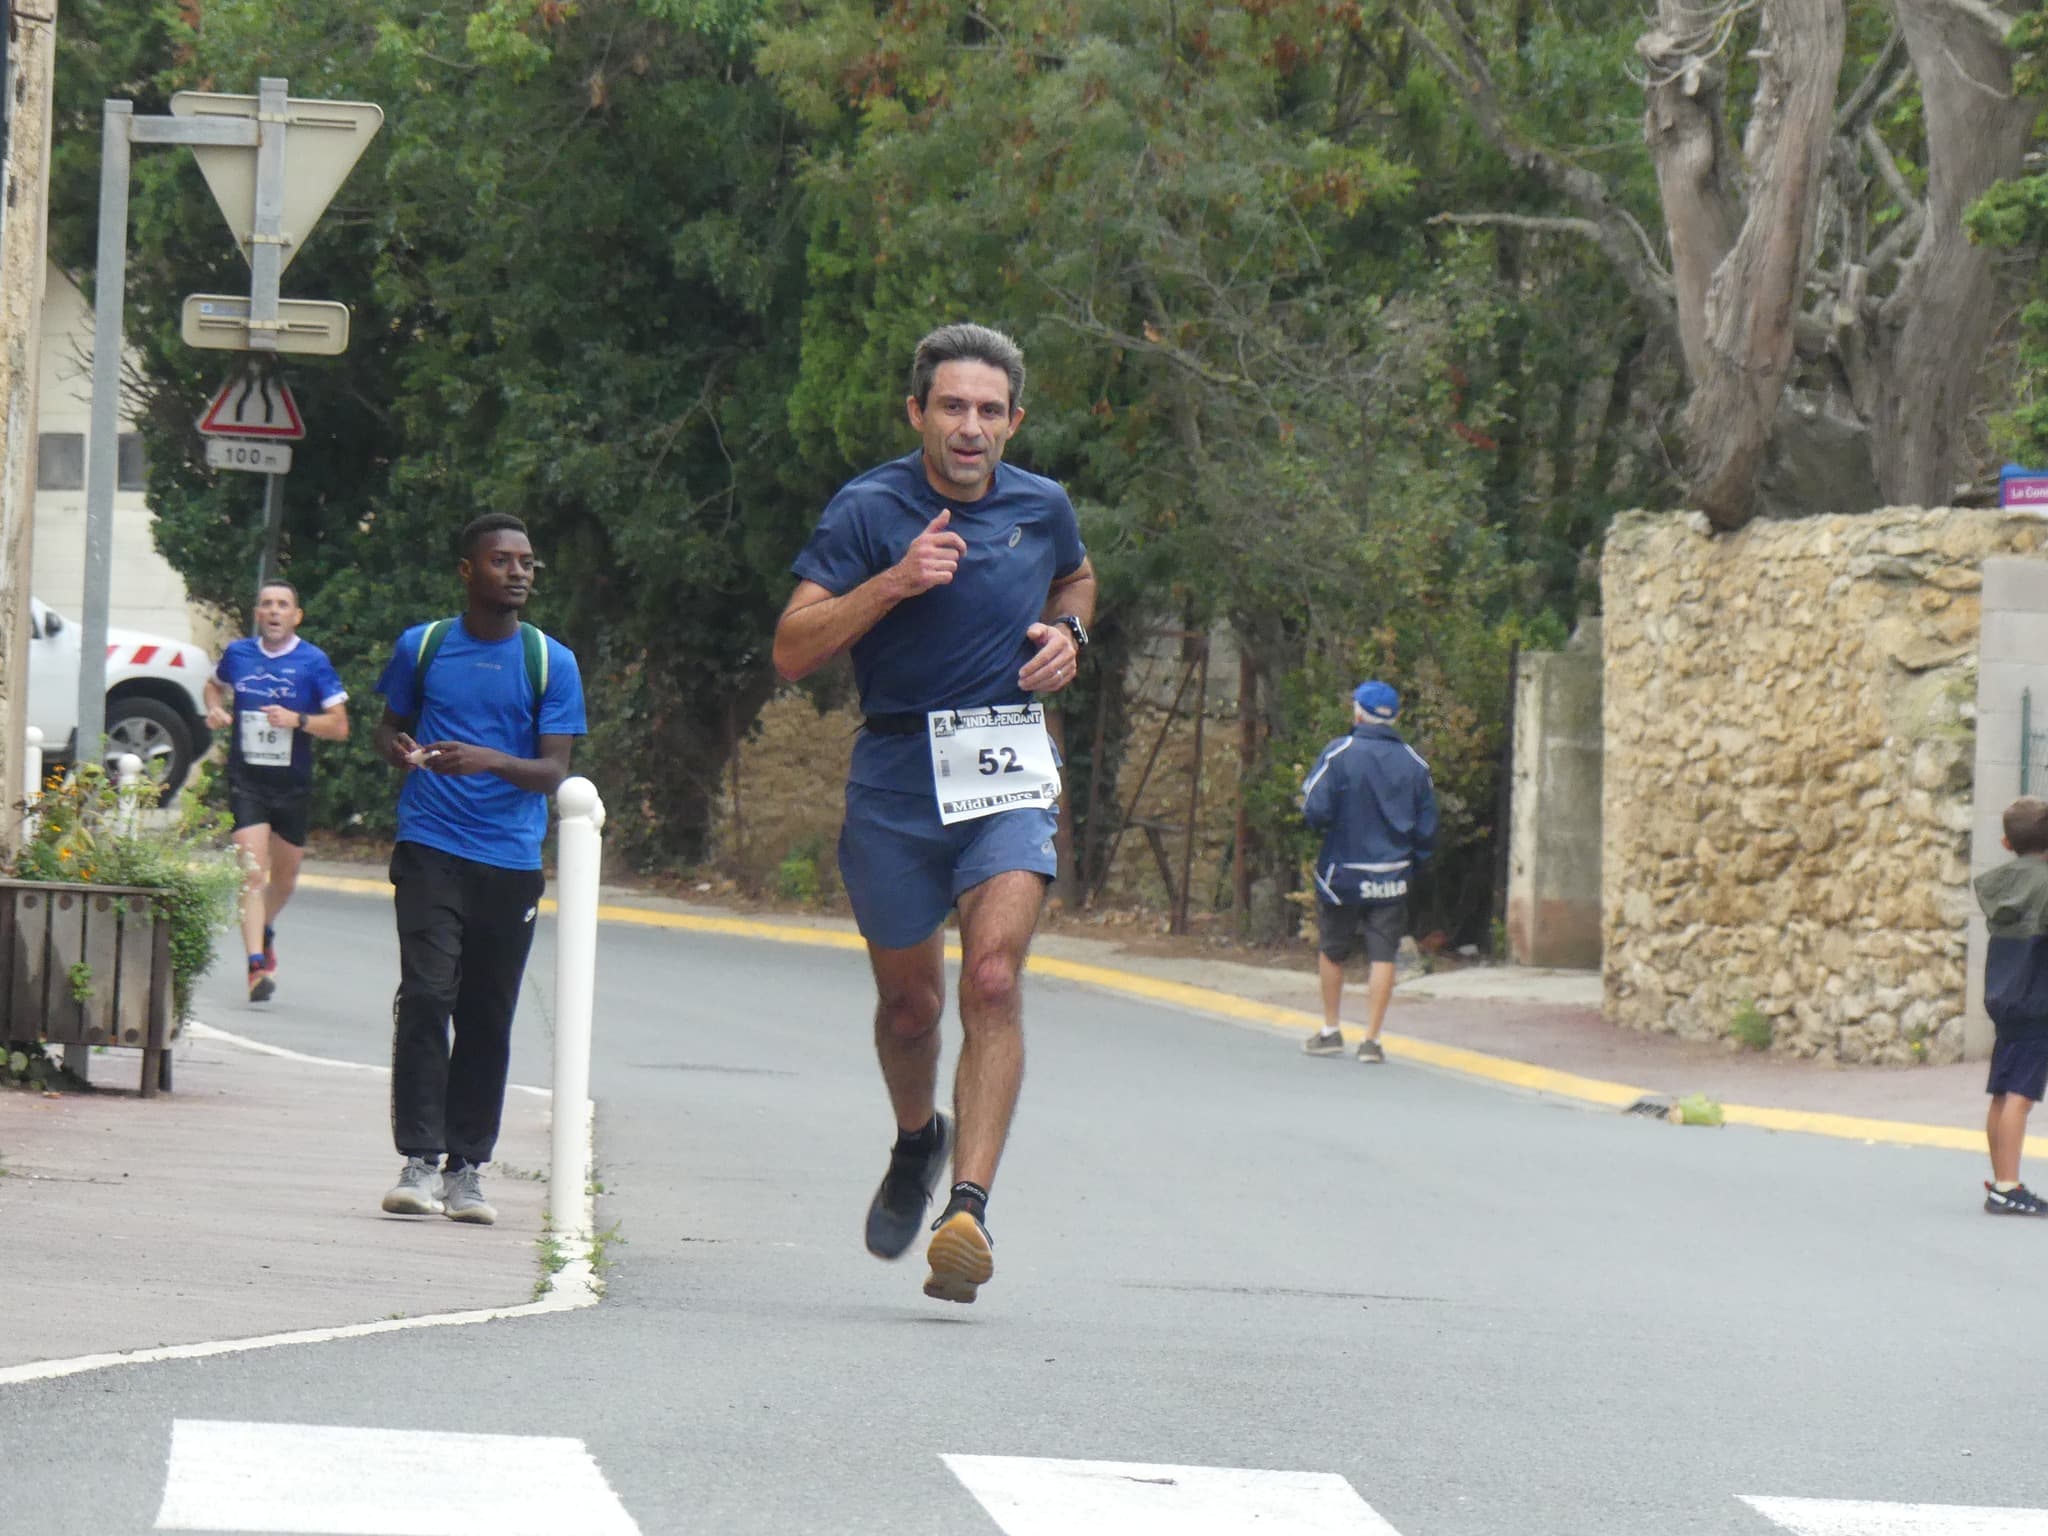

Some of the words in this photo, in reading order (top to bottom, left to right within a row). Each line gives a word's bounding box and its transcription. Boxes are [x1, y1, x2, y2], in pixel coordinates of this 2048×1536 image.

[257, 730, 277, 744] 16
[978, 746, 1025, 776] 52
[951, 797, 989, 813] Midi
[991, 791, 1034, 806] Libre
